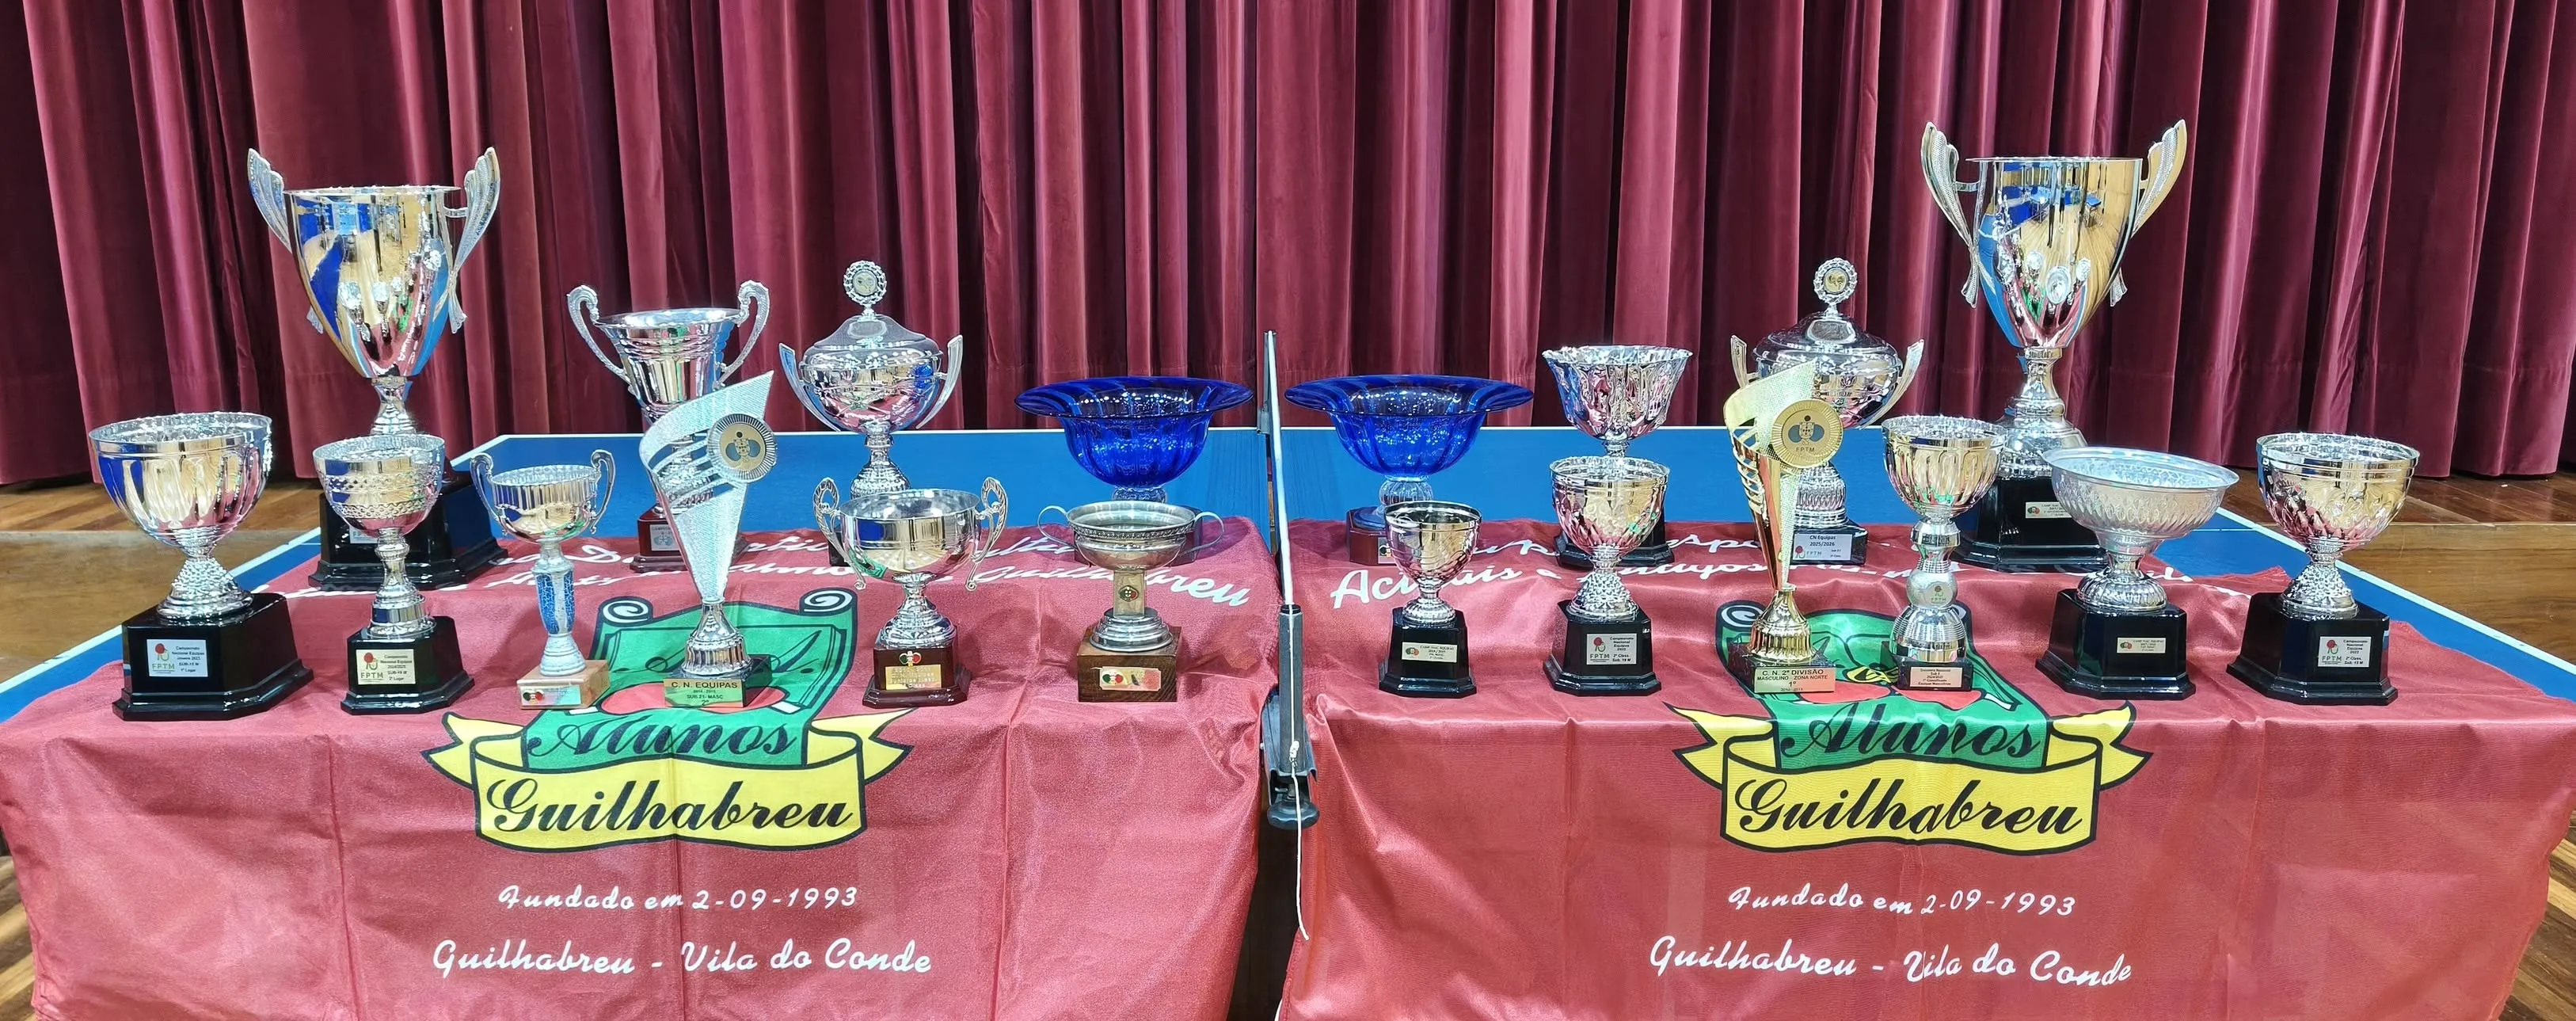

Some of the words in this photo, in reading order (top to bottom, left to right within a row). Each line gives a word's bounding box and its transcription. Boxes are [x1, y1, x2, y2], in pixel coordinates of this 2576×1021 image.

[527, 713, 797, 756] Alunos
[1781, 702, 2041, 757] Alunos
[486, 778, 853, 832] Guilhabreu
[1735, 778, 2083, 833] Guilhabreu
[497, 884, 636, 911] Fundado
[645, 893, 684, 910] em
[691, 886, 858, 911] 2-09-1993
[1728, 882, 1864, 910] Fundado
[1873, 897, 1913, 915] em
[1920, 888, 2077, 916] 2-09-1993
[432, 938, 636, 980] Guilhabreu
[681, 940, 759, 973] Vila
[770, 938, 812, 970] do
[824, 937, 933, 974] Conde
[1649, 935, 1857, 977] Guilhabreu
[1904, 944, 1962, 983] Vila
[1972, 942, 2016, 977] do
[2030, 950, 2133, 987] Conde
